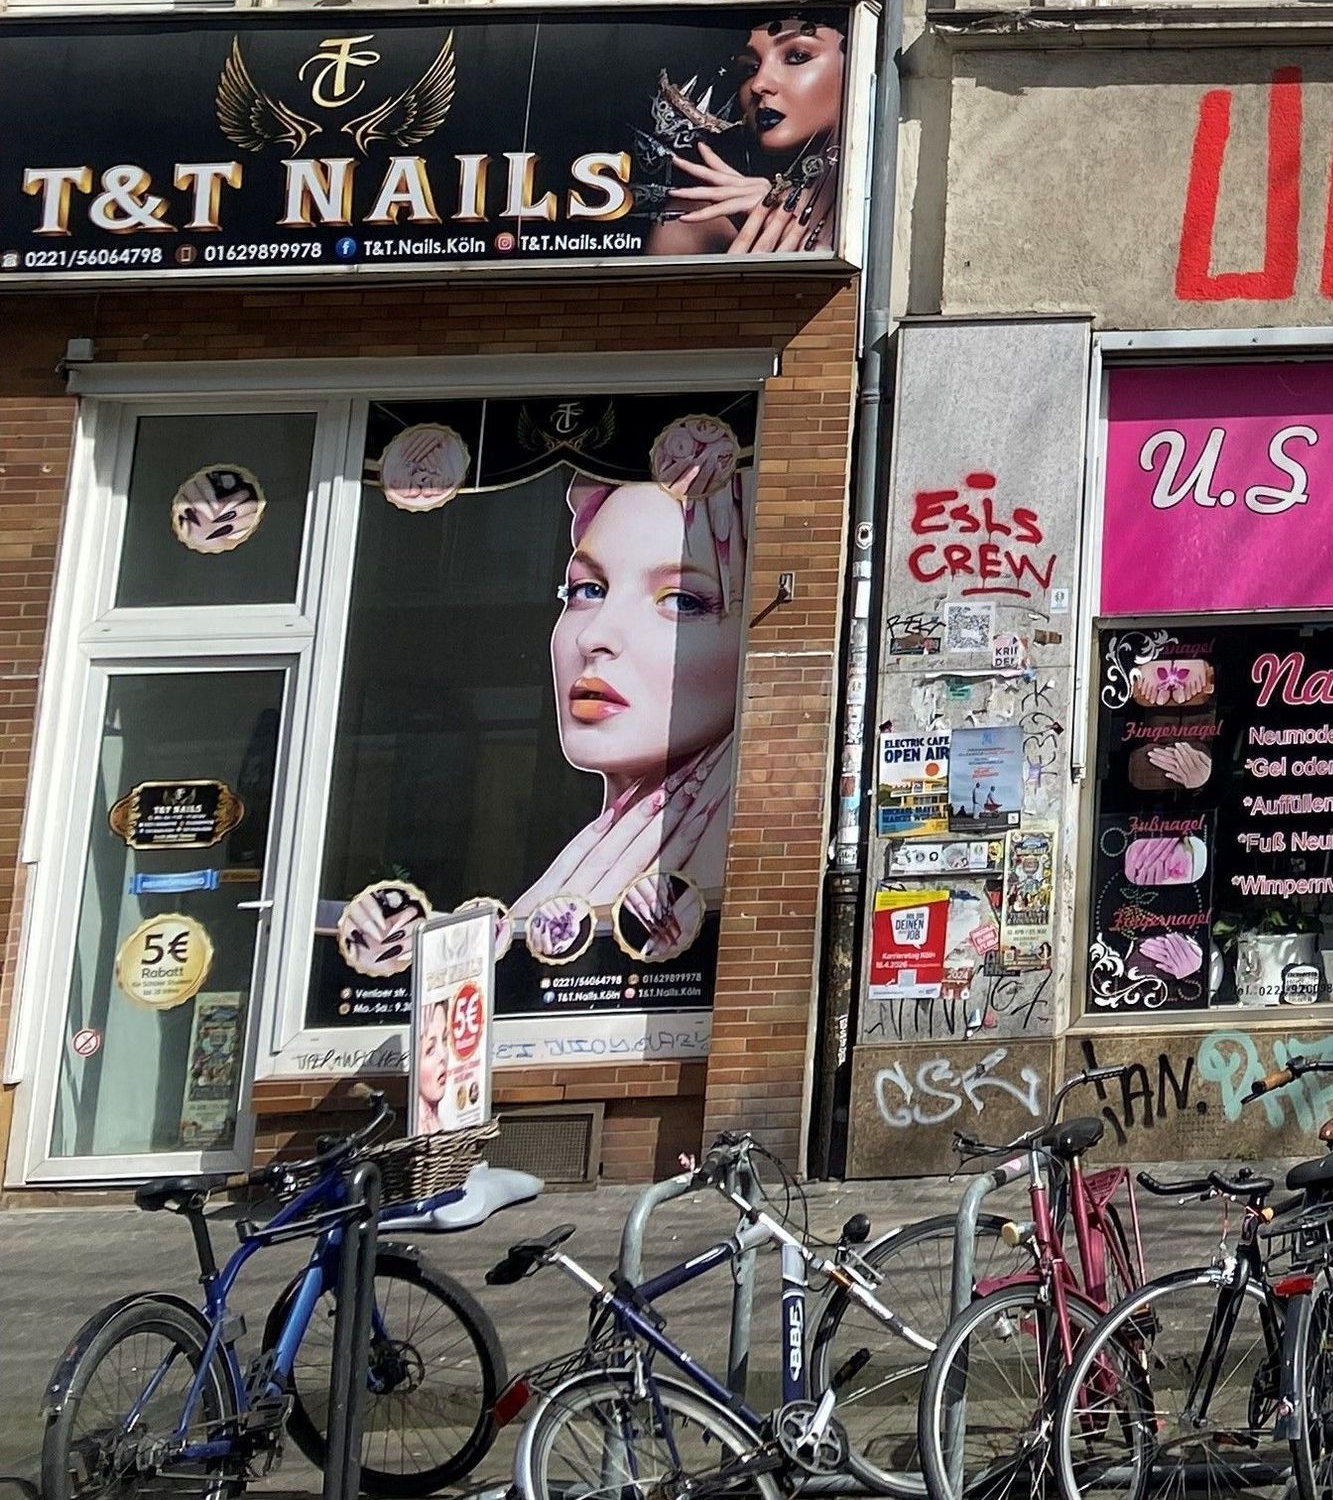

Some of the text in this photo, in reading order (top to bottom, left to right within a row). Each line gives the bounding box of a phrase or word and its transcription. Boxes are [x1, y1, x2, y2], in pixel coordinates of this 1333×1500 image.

[22, 150, 634, 237] T&T NAILS
[363, 235, 486, 256] T&T.Nails.Köln
[520, 232, 642, 251] T&T.Nails.Köln
[25, 248, 163, 268] 0221/56064798
[204, 243, 322, 262] 01629899978
[1138, 425, 1319, 516] U.S
[908, 543, 1057, 590] CREW
[1121, 718, 1224, 742] Fingernagel
[884, 737, 925, 749] ELECTRIC
[884, 746, 950, 764] OPEN AIR
[1124, 813, 1206, 836] Fußnagel
[895, 919, 924, 931] DEINEN
[906, 930, 920, 941] JOB
[141, 930, 190, 965] 5€
[141, 966, 184, 980] Rabatt
[552, 975, 622, 988] 0221/56064798
[642, 973, 702, 984] 01629899978
[453, 992, 481, 1040] 5€
